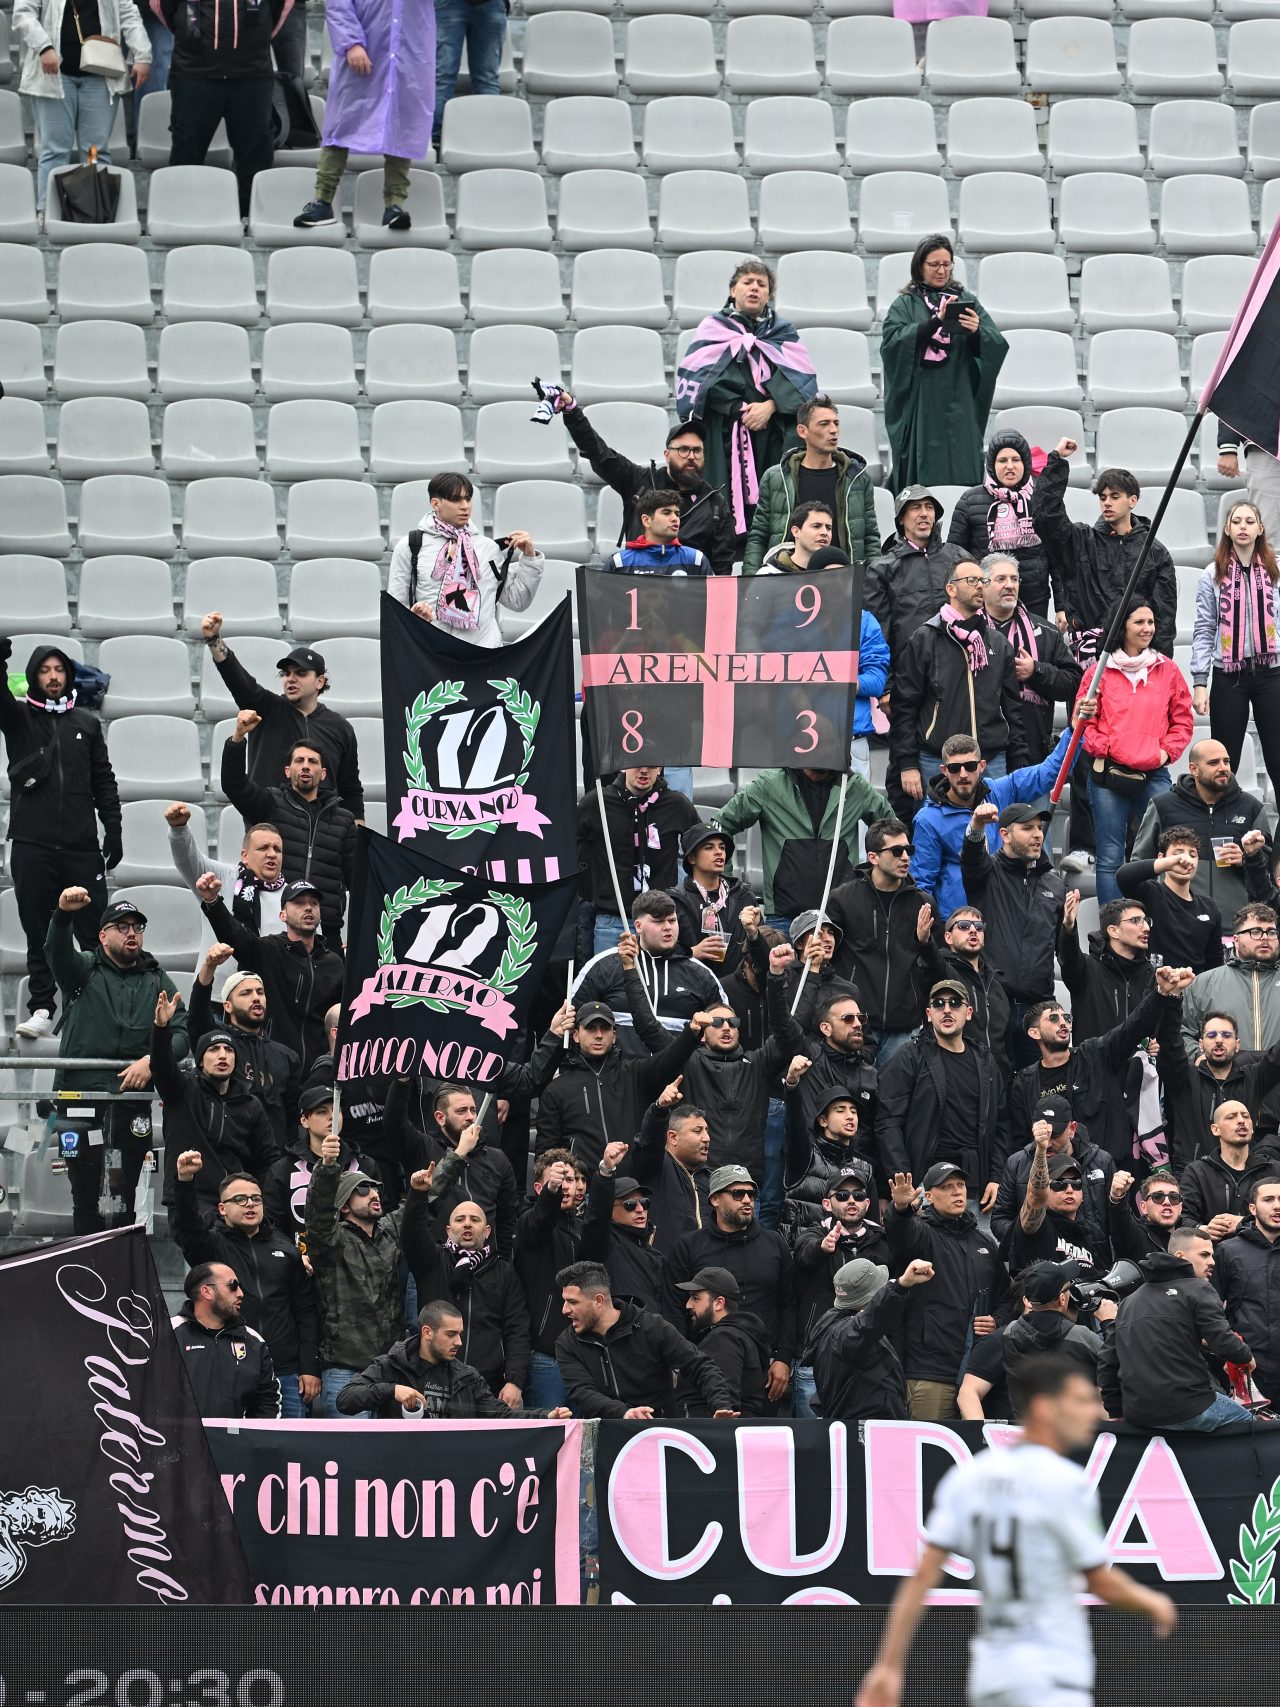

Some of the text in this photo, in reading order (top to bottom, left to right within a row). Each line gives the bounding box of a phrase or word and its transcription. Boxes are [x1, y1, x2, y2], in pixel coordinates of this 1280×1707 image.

[625, 584, 821, 630] 1 9
[608, 652, 837, 684] ARENELLA
[438, 705, 516, 790] 12
[622, 709, 819, 753] 8 3
[412, 789, 519, 821] CURVA NOD
[404, 903, 500, 978] 12
[374, 968, 498, 1008] ALERMO
[337, 1037, 504, 1083] BLOCCO NORD
[257, 1461, 338, 1536] chi
[356, 1477, 456, 1538] non
[470, 1457, 539, 1537] c'è
[608, 1419, 1225, 1581] CURA
[65, 1668, 284, 1707] 20:30
